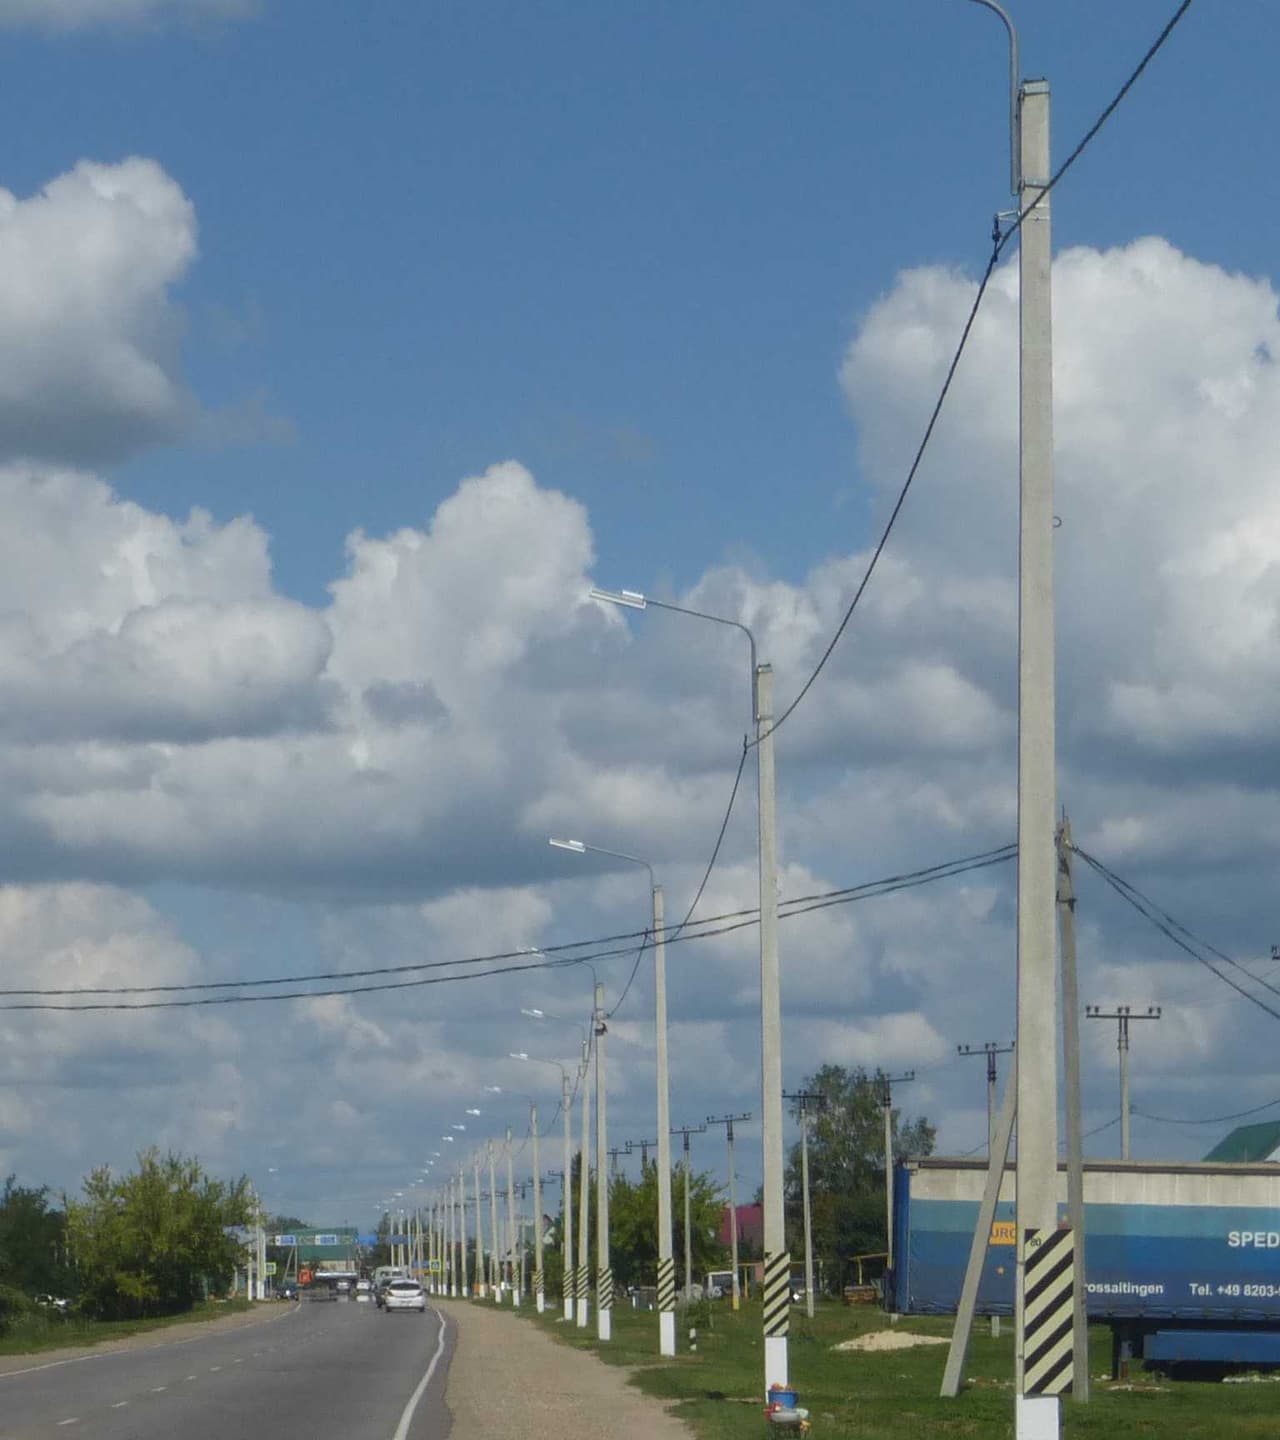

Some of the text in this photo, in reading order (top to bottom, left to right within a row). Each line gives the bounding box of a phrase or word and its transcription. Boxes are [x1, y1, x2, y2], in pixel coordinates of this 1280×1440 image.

[1085, 1282, 1164, 1297] ossaitingen
[1188, 1283, 1213, 1296] Tel.
[1216, 1284, 1240, 1296] +49
